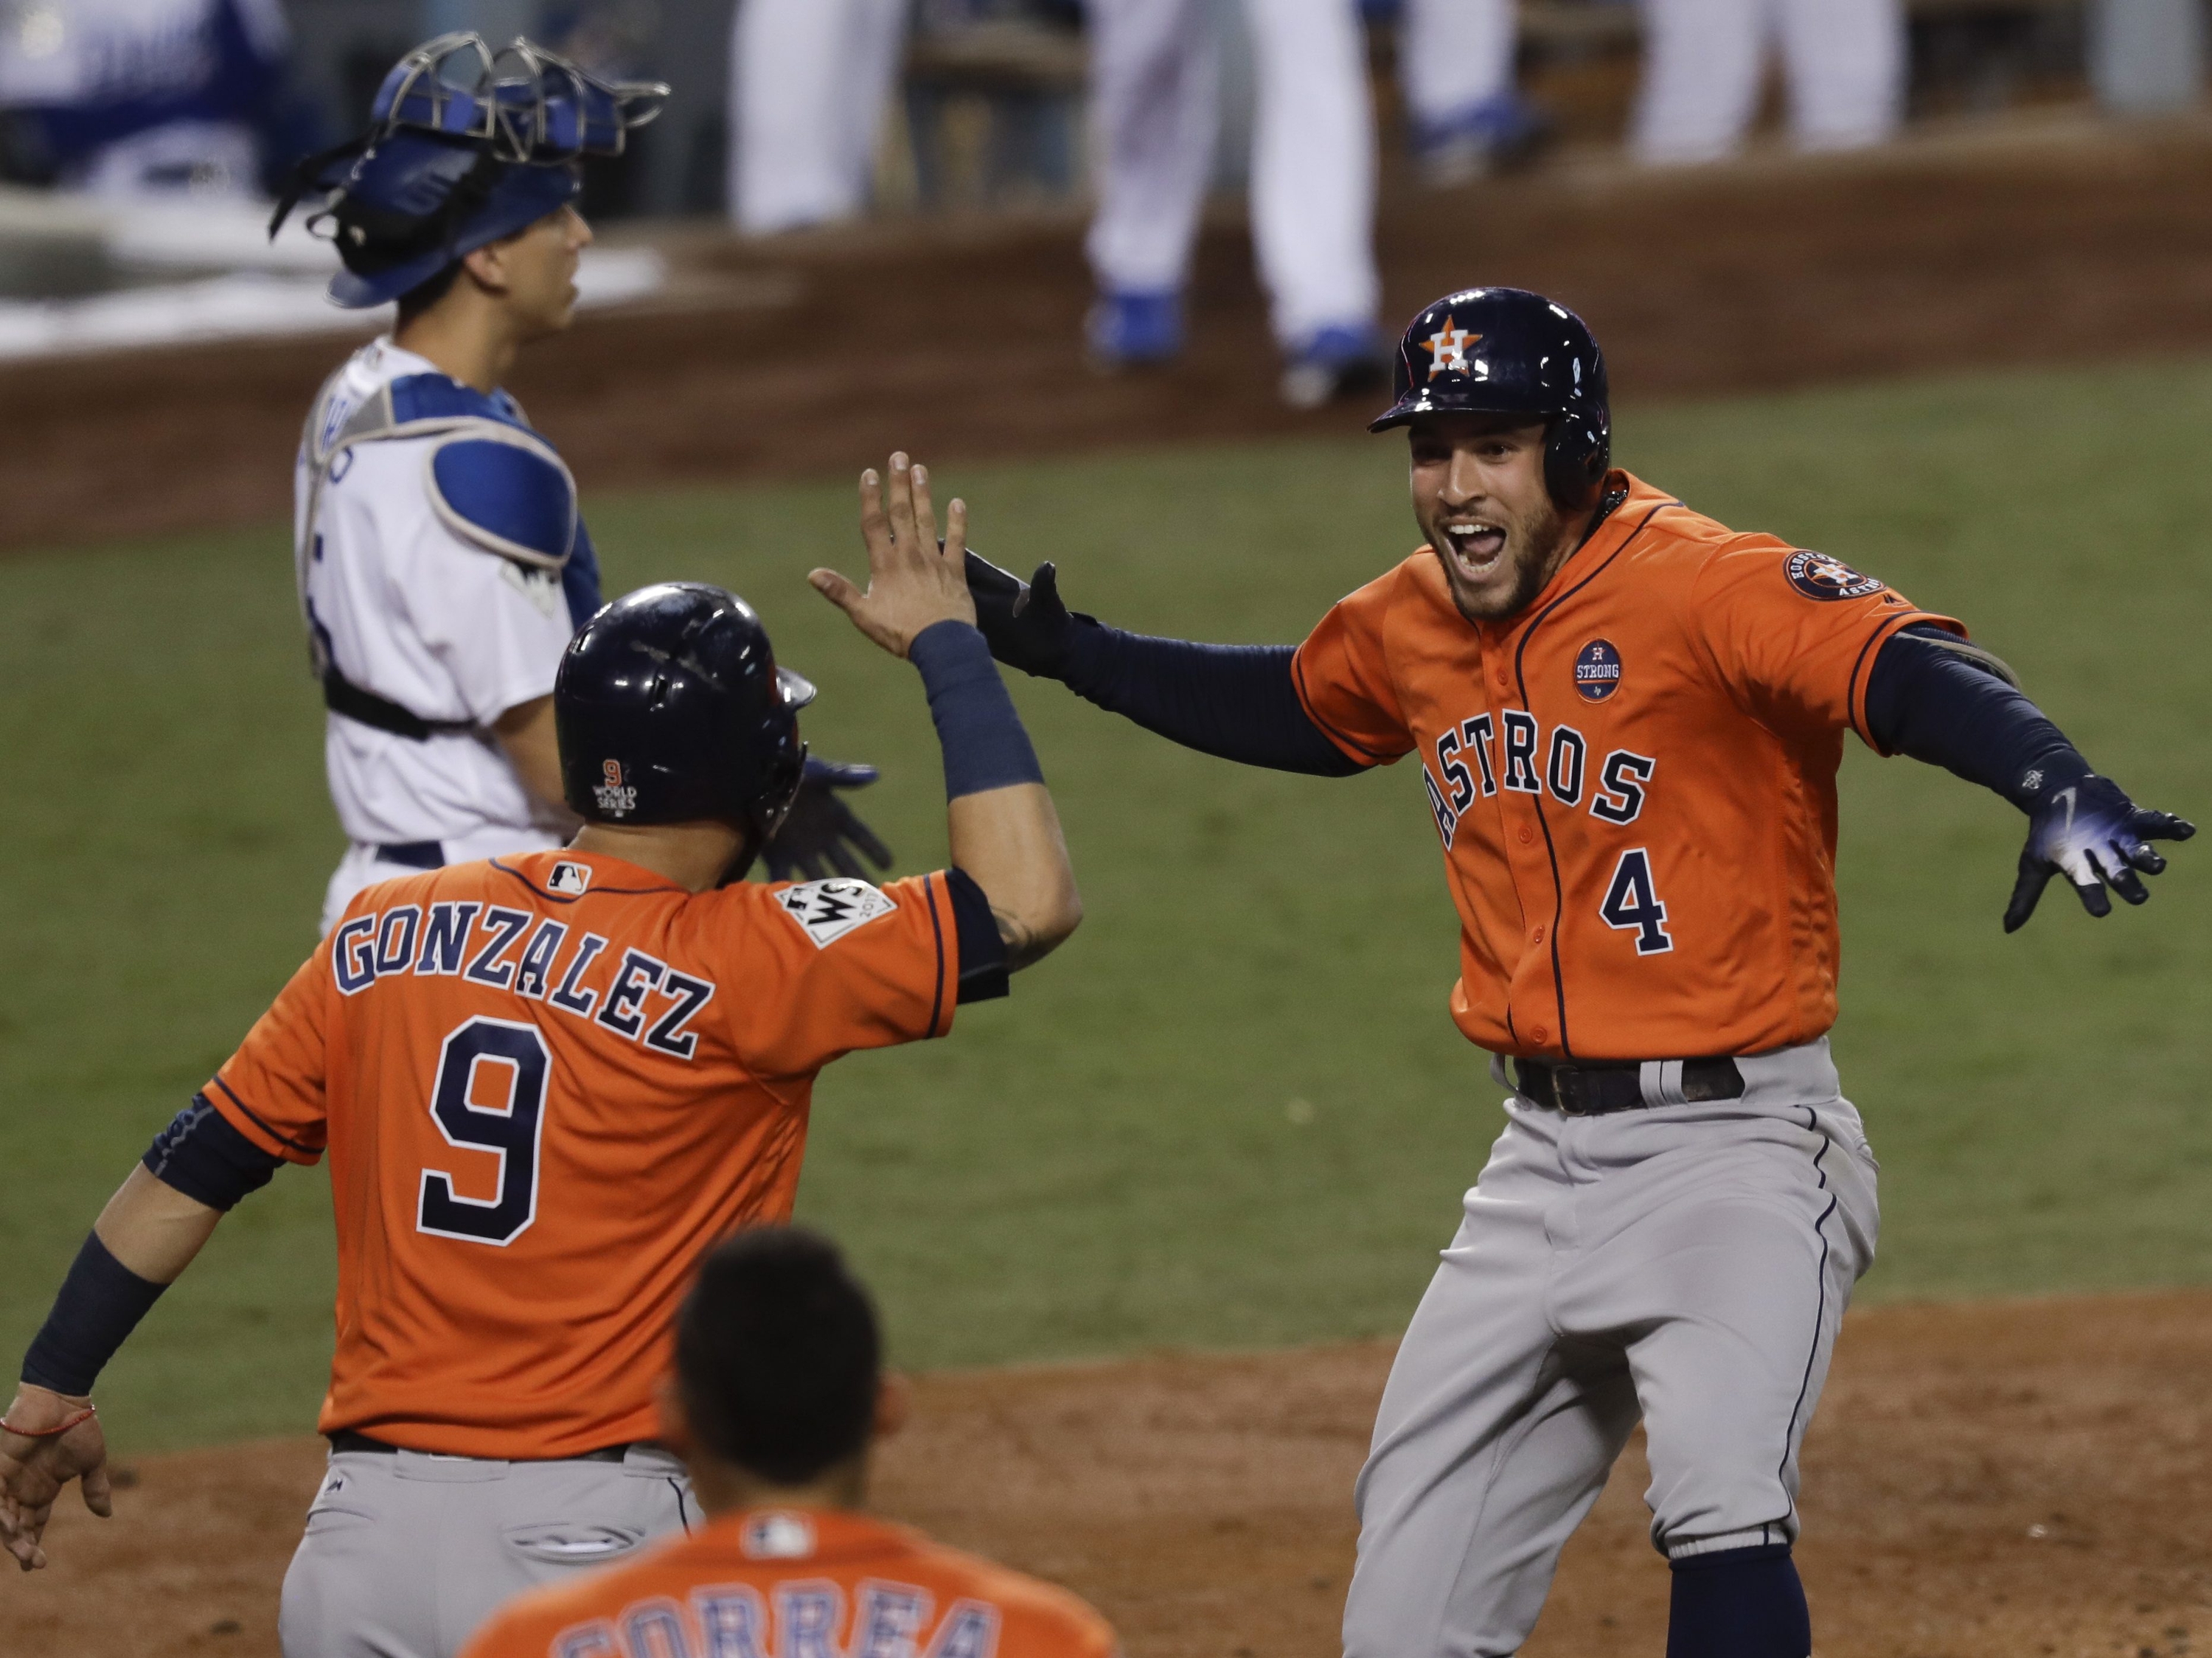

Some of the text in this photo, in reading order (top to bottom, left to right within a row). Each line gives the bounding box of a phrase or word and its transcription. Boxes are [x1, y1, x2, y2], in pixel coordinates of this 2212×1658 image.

[1429, 330, 1468, 372] H
[1839, 577, 1880, 596] ASTRO
[1576, 664, 1619, 678] STRONG
[1592, 647, 1604, 661] H
[602, 759, 622, 787] 9
[1422, 708, 1656, 851] ASTROS
[592, 785, 637, 798] WORLD
[597, 796, 636, 810] SERIES
[807, 883, 863, 925] WS
[1599, 847, 1674, 956] 4
[333, 901, 716, 1060] GONZALEZ
[416, 1014, 552, 1247] 9
